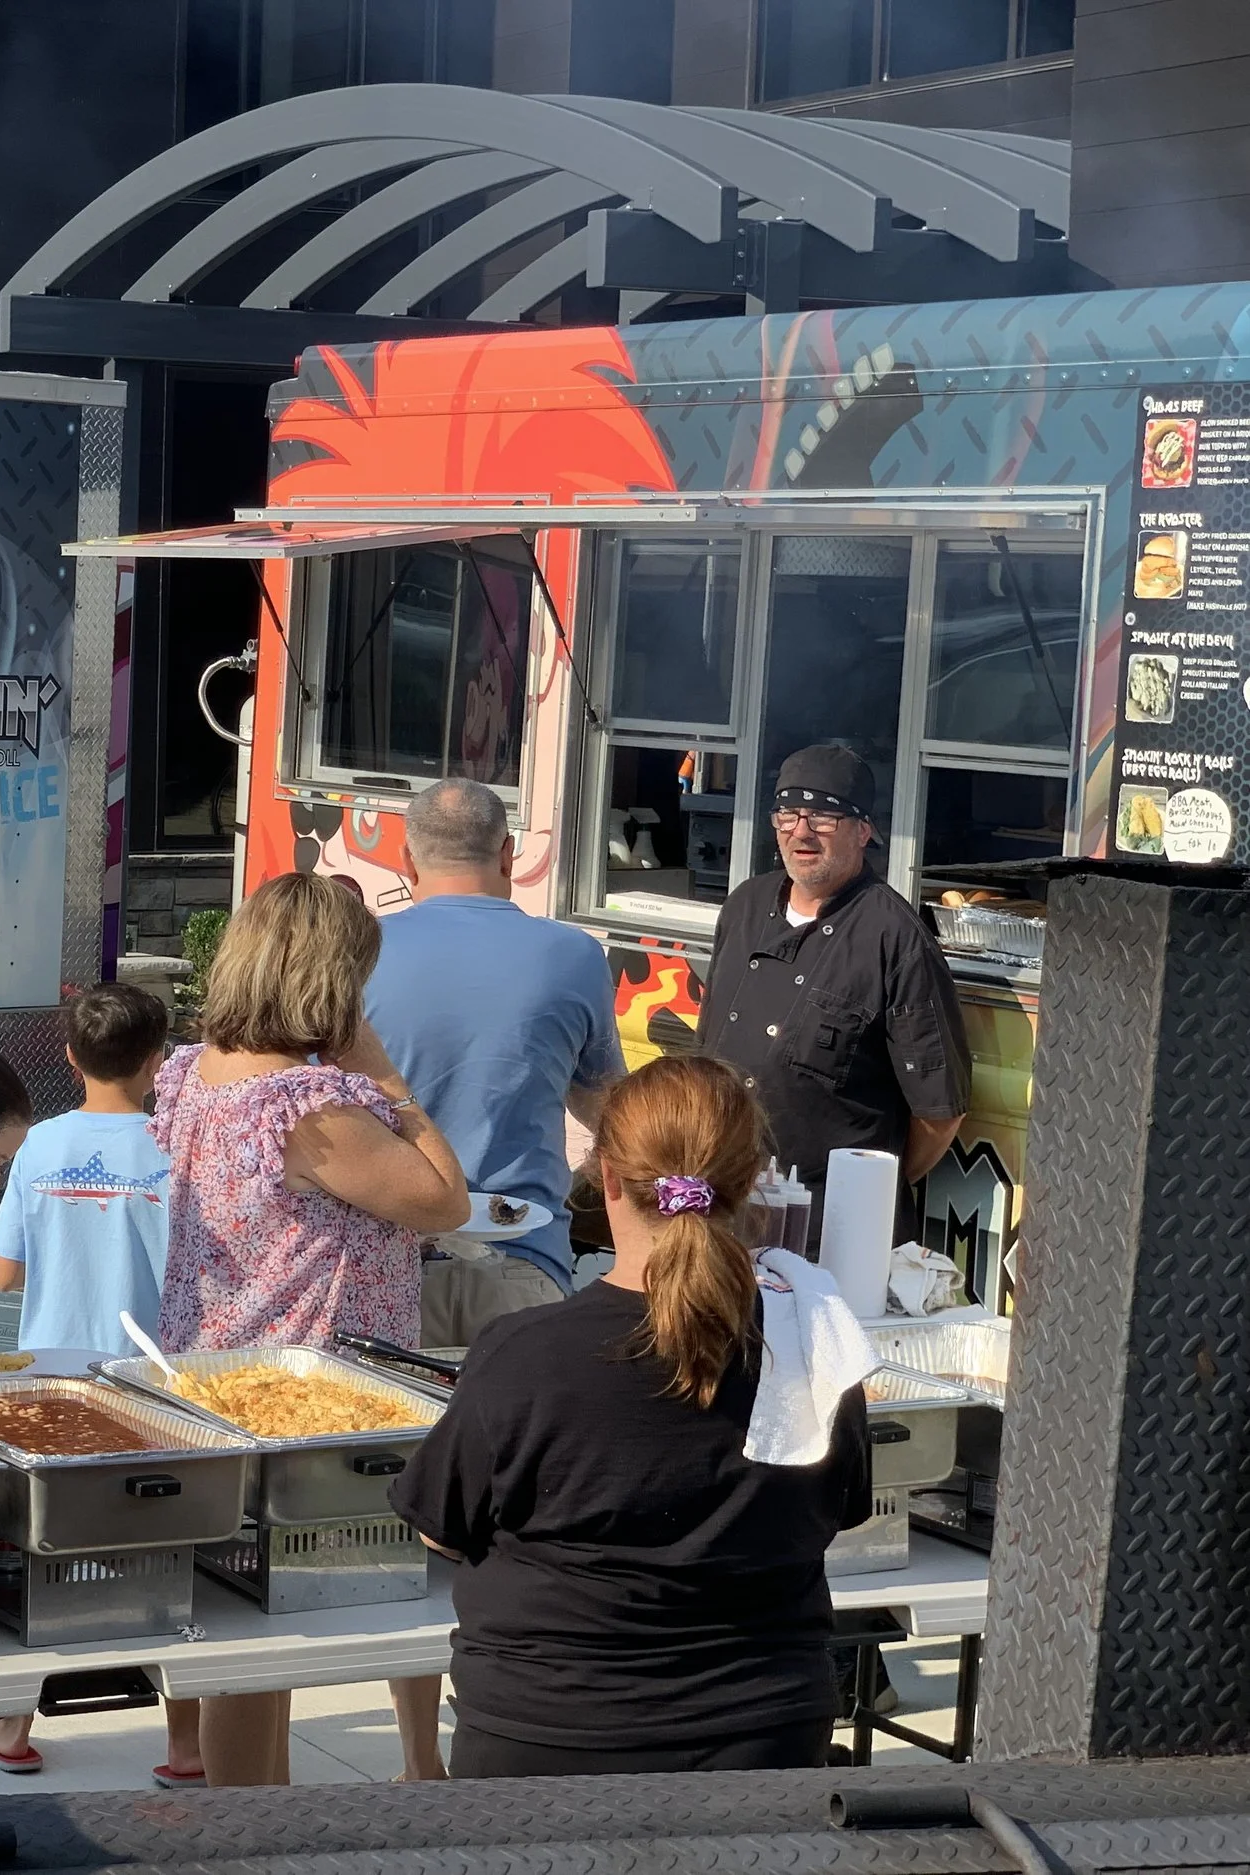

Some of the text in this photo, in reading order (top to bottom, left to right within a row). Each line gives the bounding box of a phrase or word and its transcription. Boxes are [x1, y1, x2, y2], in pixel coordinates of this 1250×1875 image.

[1181, 400, 1203, 414] BEEF
[1187, 633, 1205, 649] THE
[1206, 634, 1234, 650] DEVIL
[1173, 840, 1187, 852] 2
